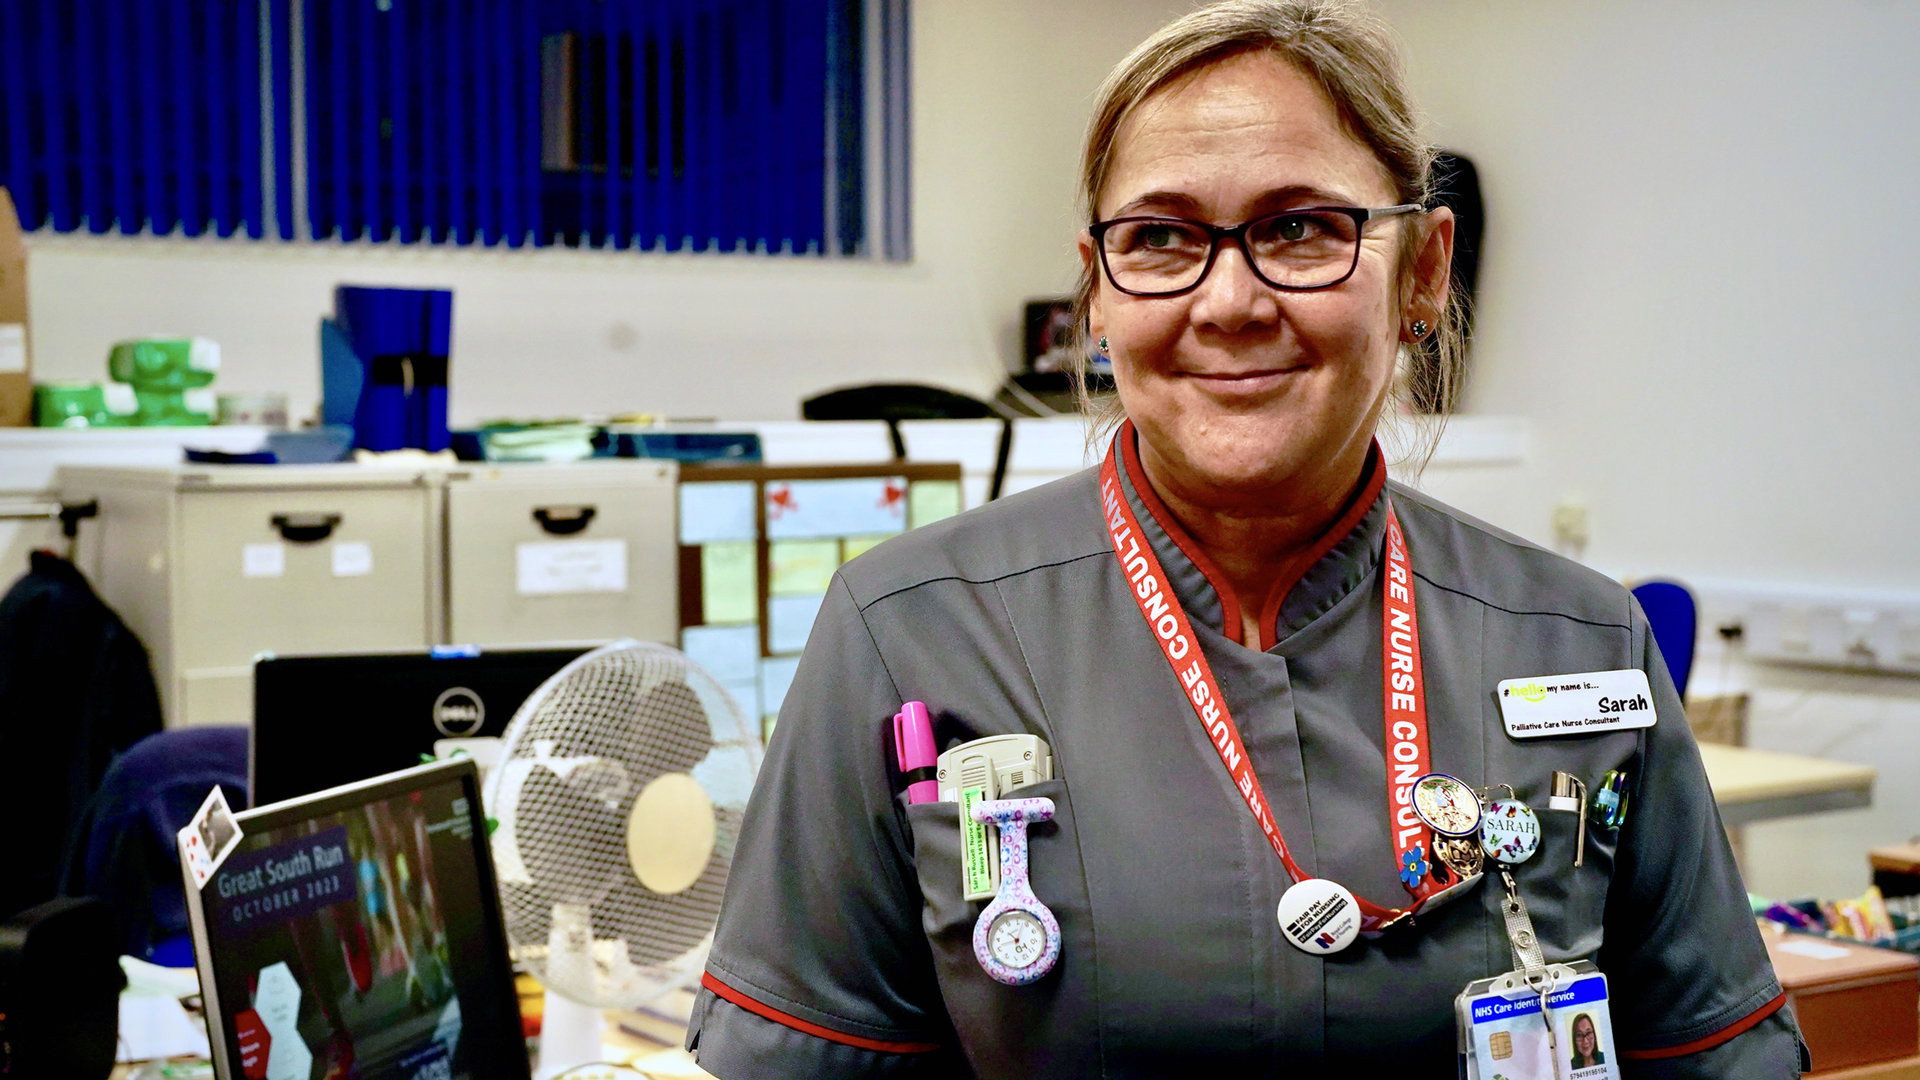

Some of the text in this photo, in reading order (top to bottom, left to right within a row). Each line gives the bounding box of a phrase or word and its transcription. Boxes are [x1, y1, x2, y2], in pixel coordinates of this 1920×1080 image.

[1102, 477, 1284, 858] CARE NURSE CONSULTANT
[1390, 524, 1422, 850] CARE NURSE CONSUL
[1547, 685, 1558, 694] my
[1598, 694, 1648, 713] Sarah
[1511, 716, 1620, 731] Palliative Care Nurse Consultant
[1487, 818, 1535, 834] SARAH
[218, 845, 344, 898] Great South Run
[232, 875, 340, 922] OCTOBER 2023
[1295, 900, 1321, 923] FAIR PAY
[1301, 892, 1340, 929] FOR NURSING
[1475, 1004, 1492, 1018] NHS
[1494, 1002, 1512, 1015] Care
[1514, 997, 1541, 1010] Identit
